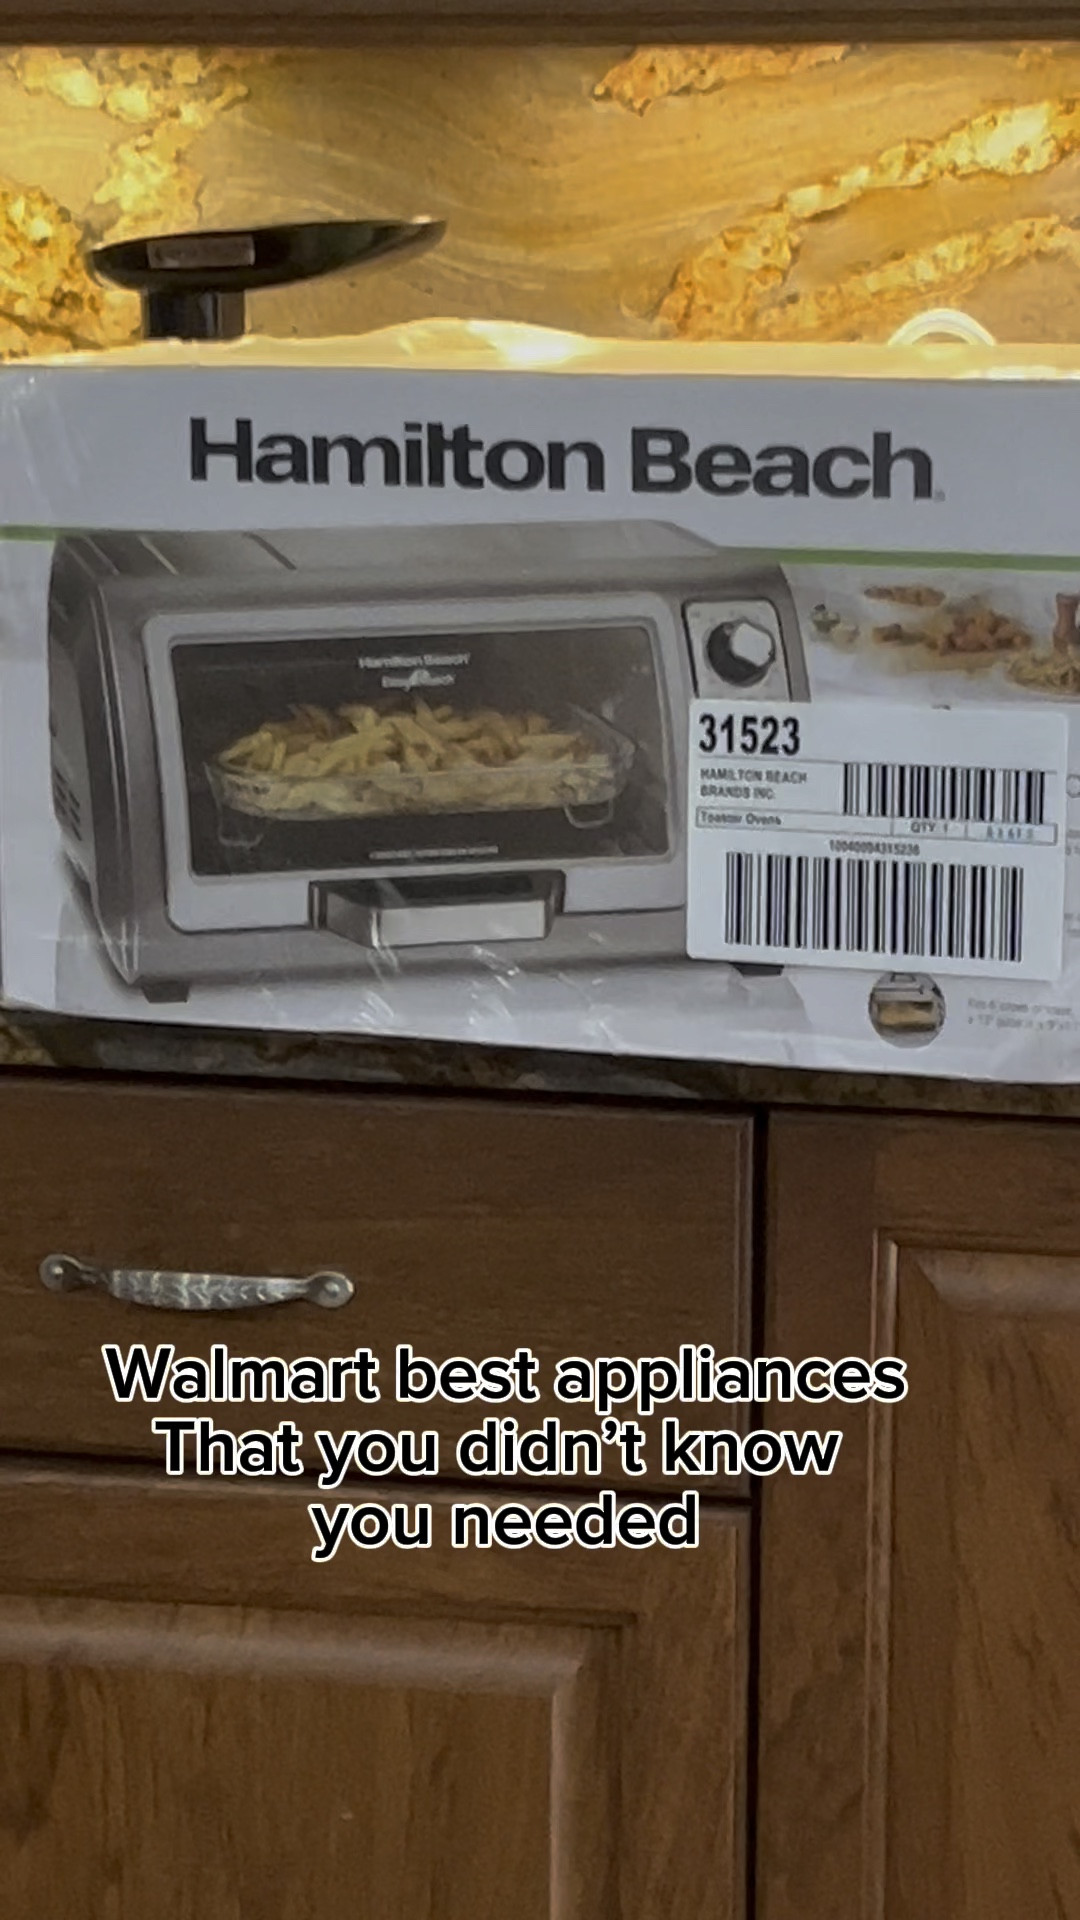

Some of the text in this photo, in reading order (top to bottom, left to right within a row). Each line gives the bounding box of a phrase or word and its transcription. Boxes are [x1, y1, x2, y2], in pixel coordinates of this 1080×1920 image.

[190, 417, 934, 499] Hamilton Beach
[699, 713, 800, 756] 31523
[700, 768, 808, 785] HAMILTON BEACH
[700, 784, 750, 799] BRANDS
[745, 812, 782, 825] Ovens
[910, 821, 936, 834] QTY
